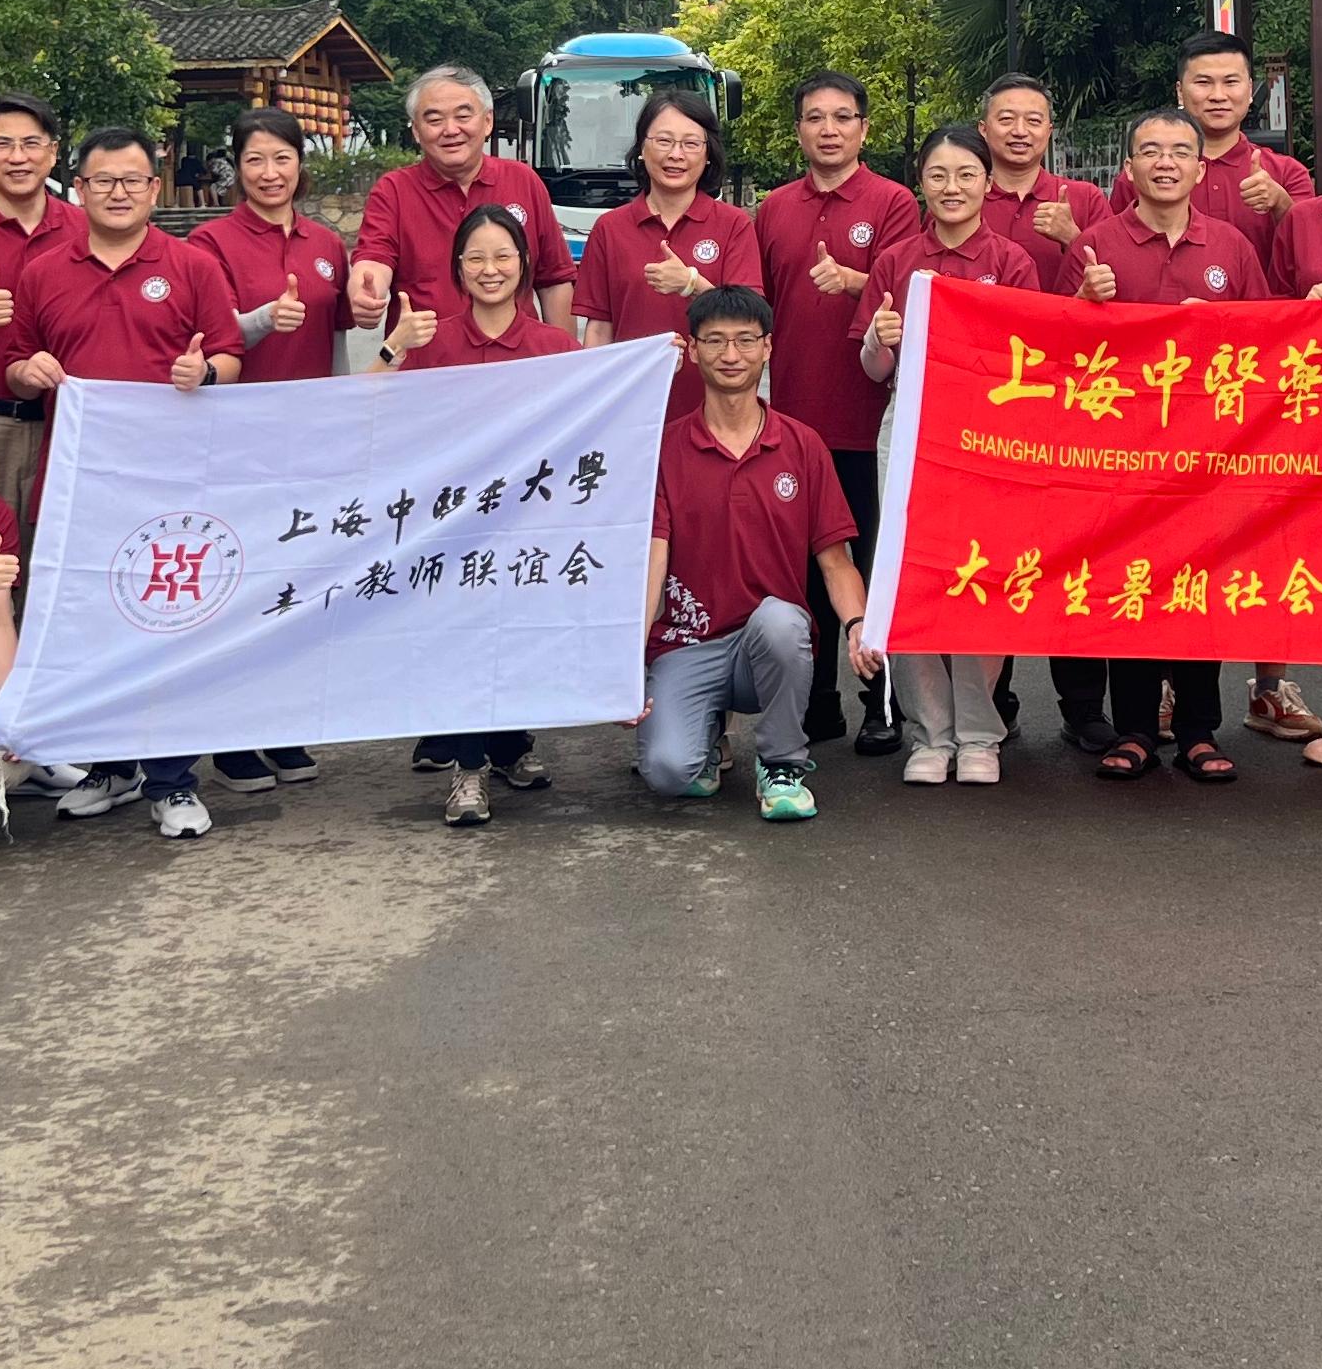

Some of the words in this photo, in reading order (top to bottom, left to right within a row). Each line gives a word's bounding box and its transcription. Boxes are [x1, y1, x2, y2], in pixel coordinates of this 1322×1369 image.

[960, 429, 1054, 464] SHANGHAI
[1059, 445, 1169, 471] UNIVERSITY
[1174, 451, 1201, 473] OF
